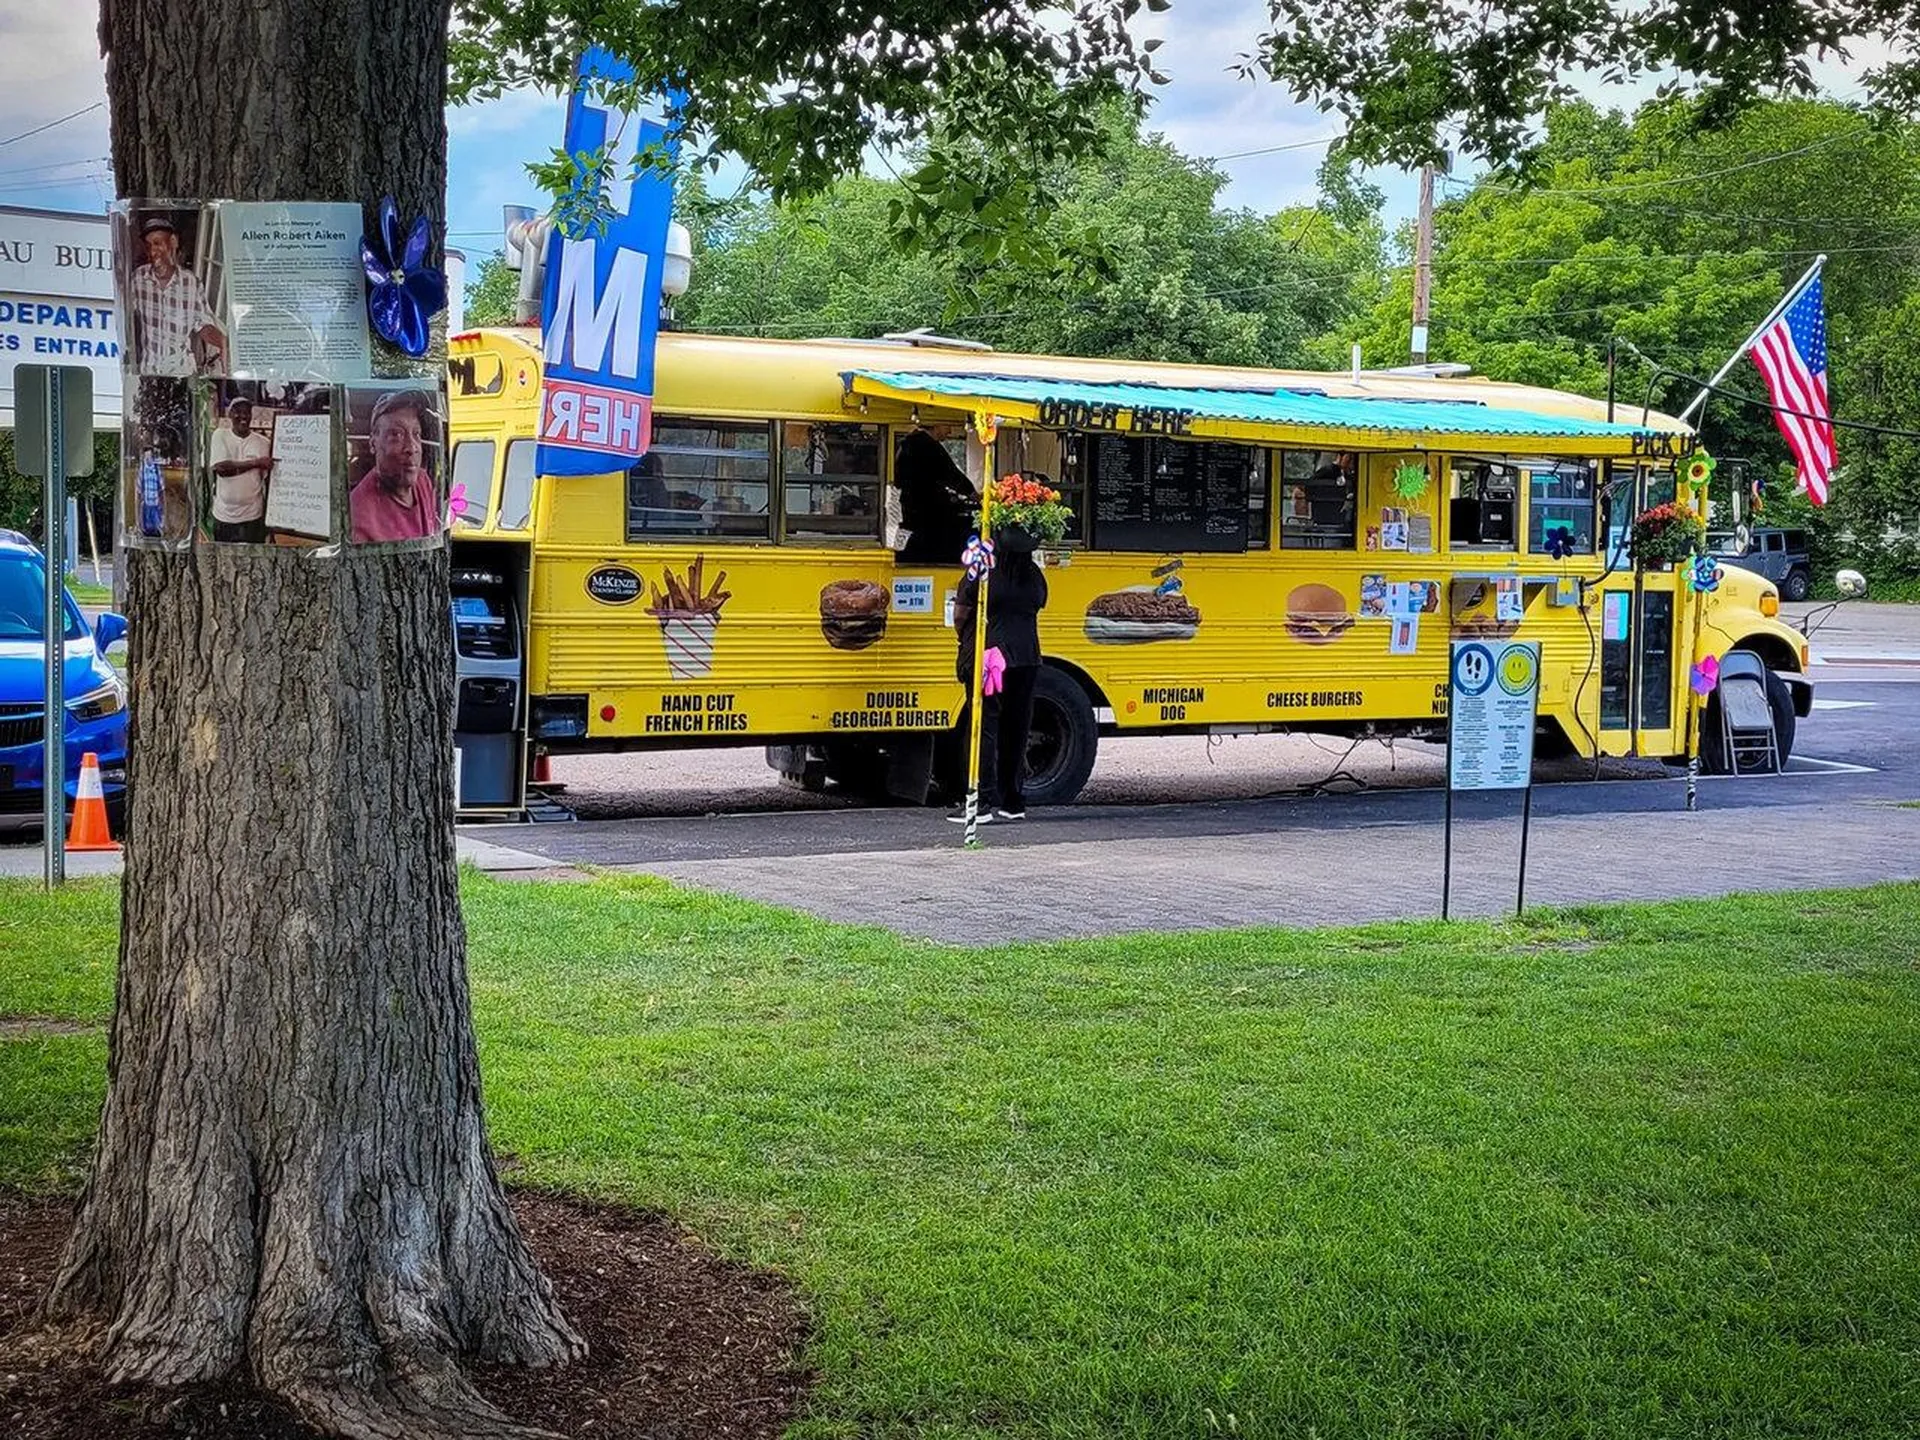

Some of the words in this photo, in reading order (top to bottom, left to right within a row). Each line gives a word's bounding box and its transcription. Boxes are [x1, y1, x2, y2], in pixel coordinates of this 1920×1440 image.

[242, 231, 270, 240] Allen
[273, 231, 311, 240] Robert
[314, 230, 346, 240] Aiken
[0, 302, 112, 329] DEPART
[1043, 396, 1115, 429] ORDER
[1134, 405, 1194, 434] HERE
[1632, 431, 1675, 457] PICK
[895, 584, 913, 593] CASH
[909, 598, 925, 606] ATM
[662, 695, 702, 711] HAND
[707, 694, 735, 711] CUT
[866, 692, 919, 708] DOUBLE
[1143, 687, 1204, 703] MICHIGAN
[1267, 692, 1308, 707] CHEESE
[1311, 691, 1363, 706] BURGERS
[832, 711, 892, 727] GEORGIA
[896, 710, 949, 726] BURGER
[1161, 704, 1185, 720] DOG
[646, 714, 703, 731] FRENCH
[707, 714, 747, 731] FRIES
